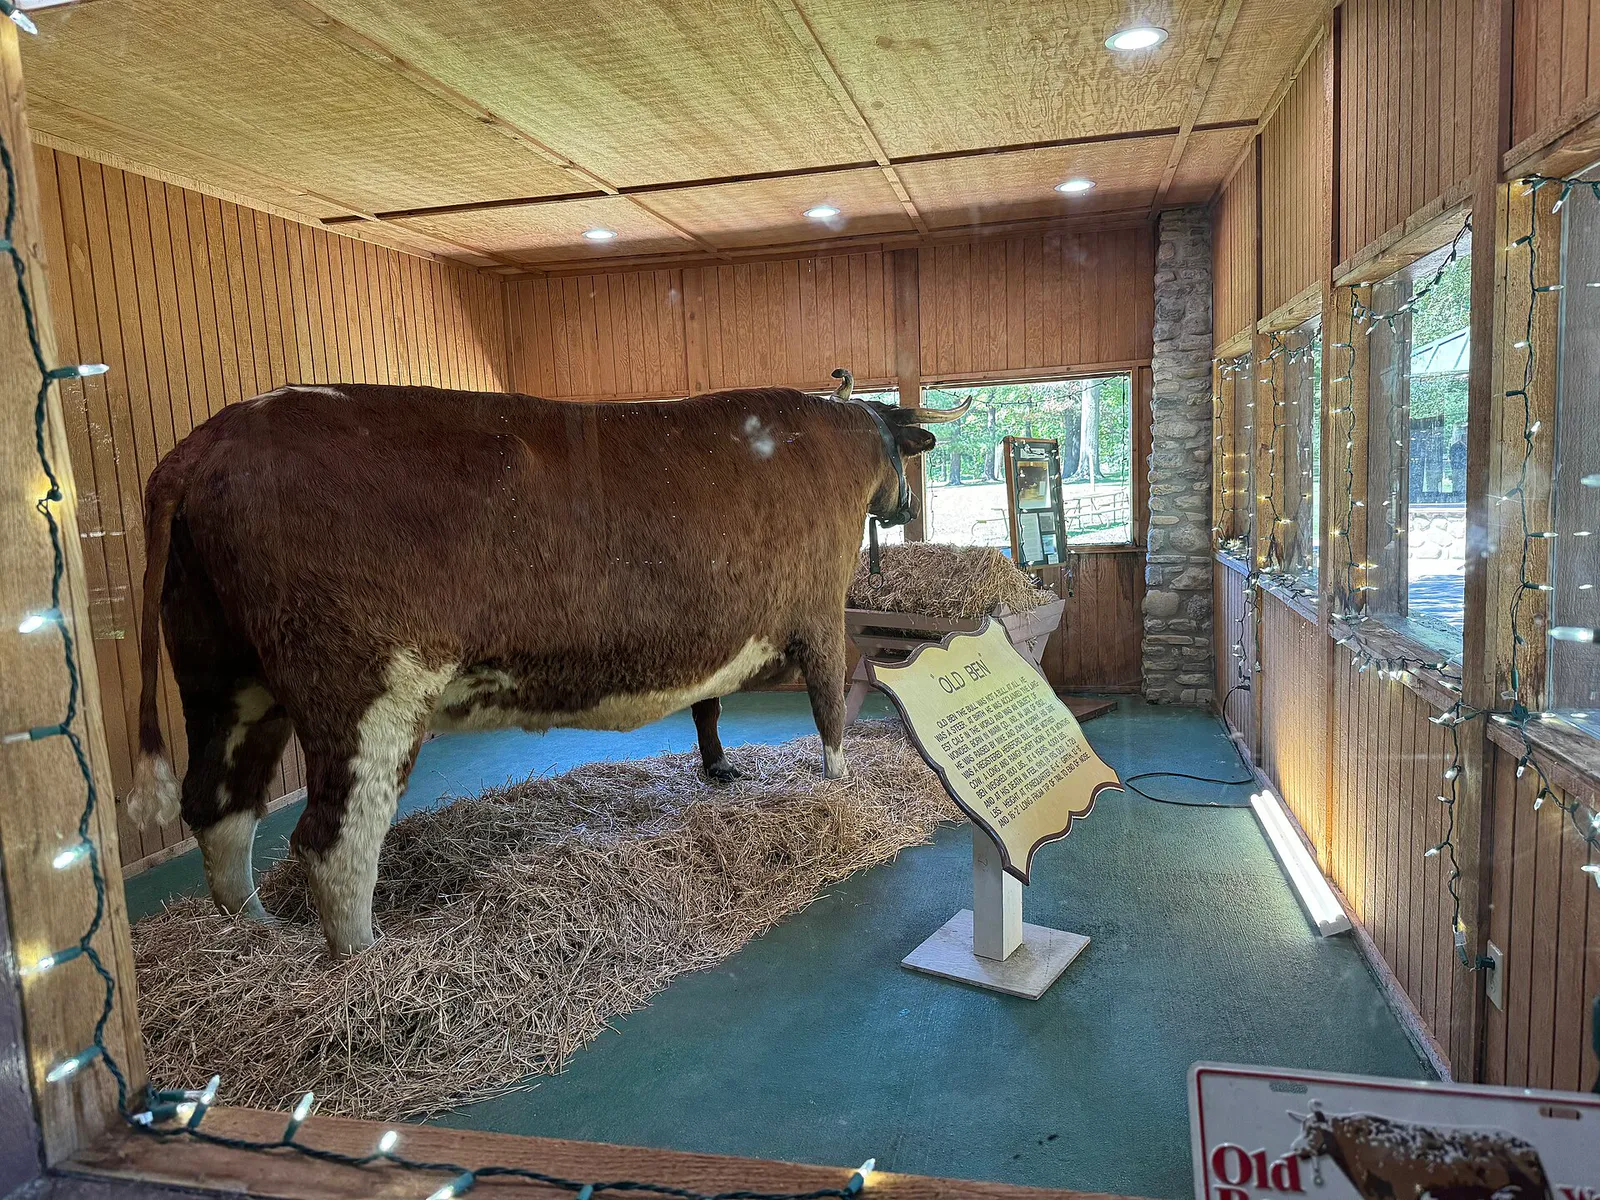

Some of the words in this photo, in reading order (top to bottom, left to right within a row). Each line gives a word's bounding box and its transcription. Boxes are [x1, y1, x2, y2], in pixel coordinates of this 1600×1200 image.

[934, 731, 947, 742] WAS
[972, 710, 986, 721] BIRTH
[991, 701, 1002, 710] WAS
[936, 719, 948, 728] OLD
[946, 713, 958, 723] BEN
[956, 708, 968, 717] THE
[965, 703, 978, 713] BULL
[975, 697, 987, 707] WAS
[941, 741, 953, 752] EST
[951, 734, 964, 746] CALF
[969, 725, 980, 735] THE
[978, 717, 995, 730] WORLD
[994, 712, 1004, 721] AND
[1001, 707, 1012, 716] WAS
[1017, 695, 1032, 707] OBJECT
[961, 768, 974, 780] WAS
[976, 750, 1003, 770] REGISTERED
[1001, 737, 1022, 754] HEREFORD
[1032, 724, 1041, 734] THE
[1039, 716, 1056, 728] MOTHER
[962, 754, 975, 765] WAS
[973, 744, 990, 758] RAISED
[995, 734, 1007, 745] MIKE
[1006, 729, 1015, 739] AND
[1014, 722, 1026, 733] JOHN
[969, 735, 984, 748] BORN
[986, 765, 1001, 777] LONG
[999, 758, 1009, 769] AND
[1008, 749, 1022, 762] RANGY
[1021, 741, 1035, 753] SHORT
[976, 787, 988, 799] BEN
[986, 774, 1007, 791] WEIGHED
[984, 796, 995, 809] AND
[999, 786, 1010, 796] HIS
[1008, 776, 1024, 790] DEATH
[998, 816, 1009, 828] AND
[1019, 797, 1033, 810] LONG
[1031, 788, 1045, 801] FROM
[1042, 783, 1050, 792] TIP
[1054, 773, 1064, 782] TAIL
[1066, 763, 1075, 773] END
[1002, 792, 1020, 809] HEIGHT
[1211, 1144, 1305, 1193] Old
